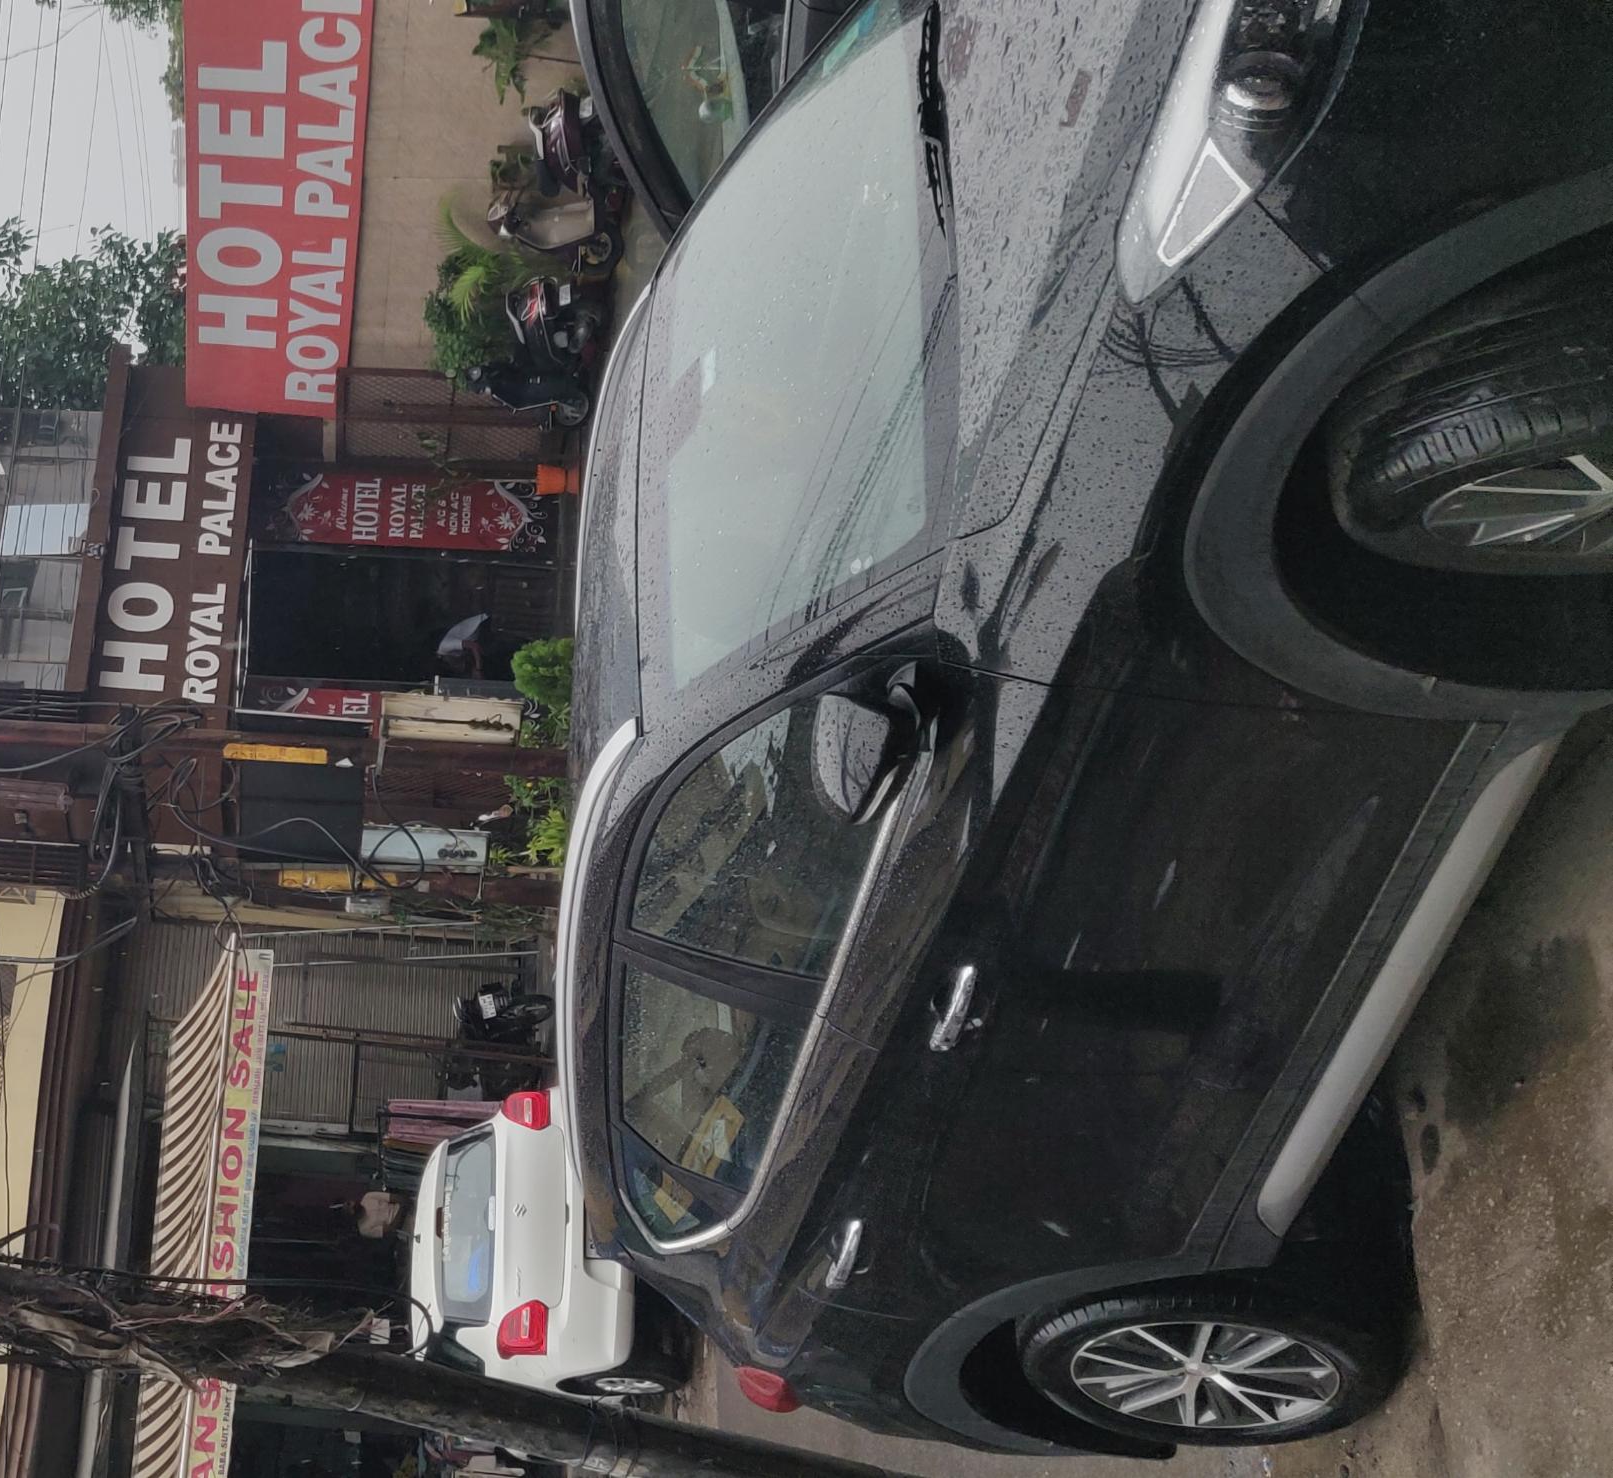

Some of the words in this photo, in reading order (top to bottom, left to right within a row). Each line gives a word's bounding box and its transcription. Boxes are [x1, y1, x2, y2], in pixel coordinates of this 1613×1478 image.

[196, 39, 288, 349] HOTEL
[284, 237, 348, 403] ROYAL
[196, 421, 244, 555] PALACE
[335, 487, 349, 531] Welcome
[352, 478, 381, 541] HOTEL
[388, 483, 408, 538] ROYAL
[449, 512, 459, 535] NON
[462, 495, 472, 533] ROOMS
[99, 438, 192, 693] HOTEL
[181, 583, 227, 704] ROYAL
[227, 968, 259, 1088] SALE
[210, 1108, 246, 1297] ASHION
